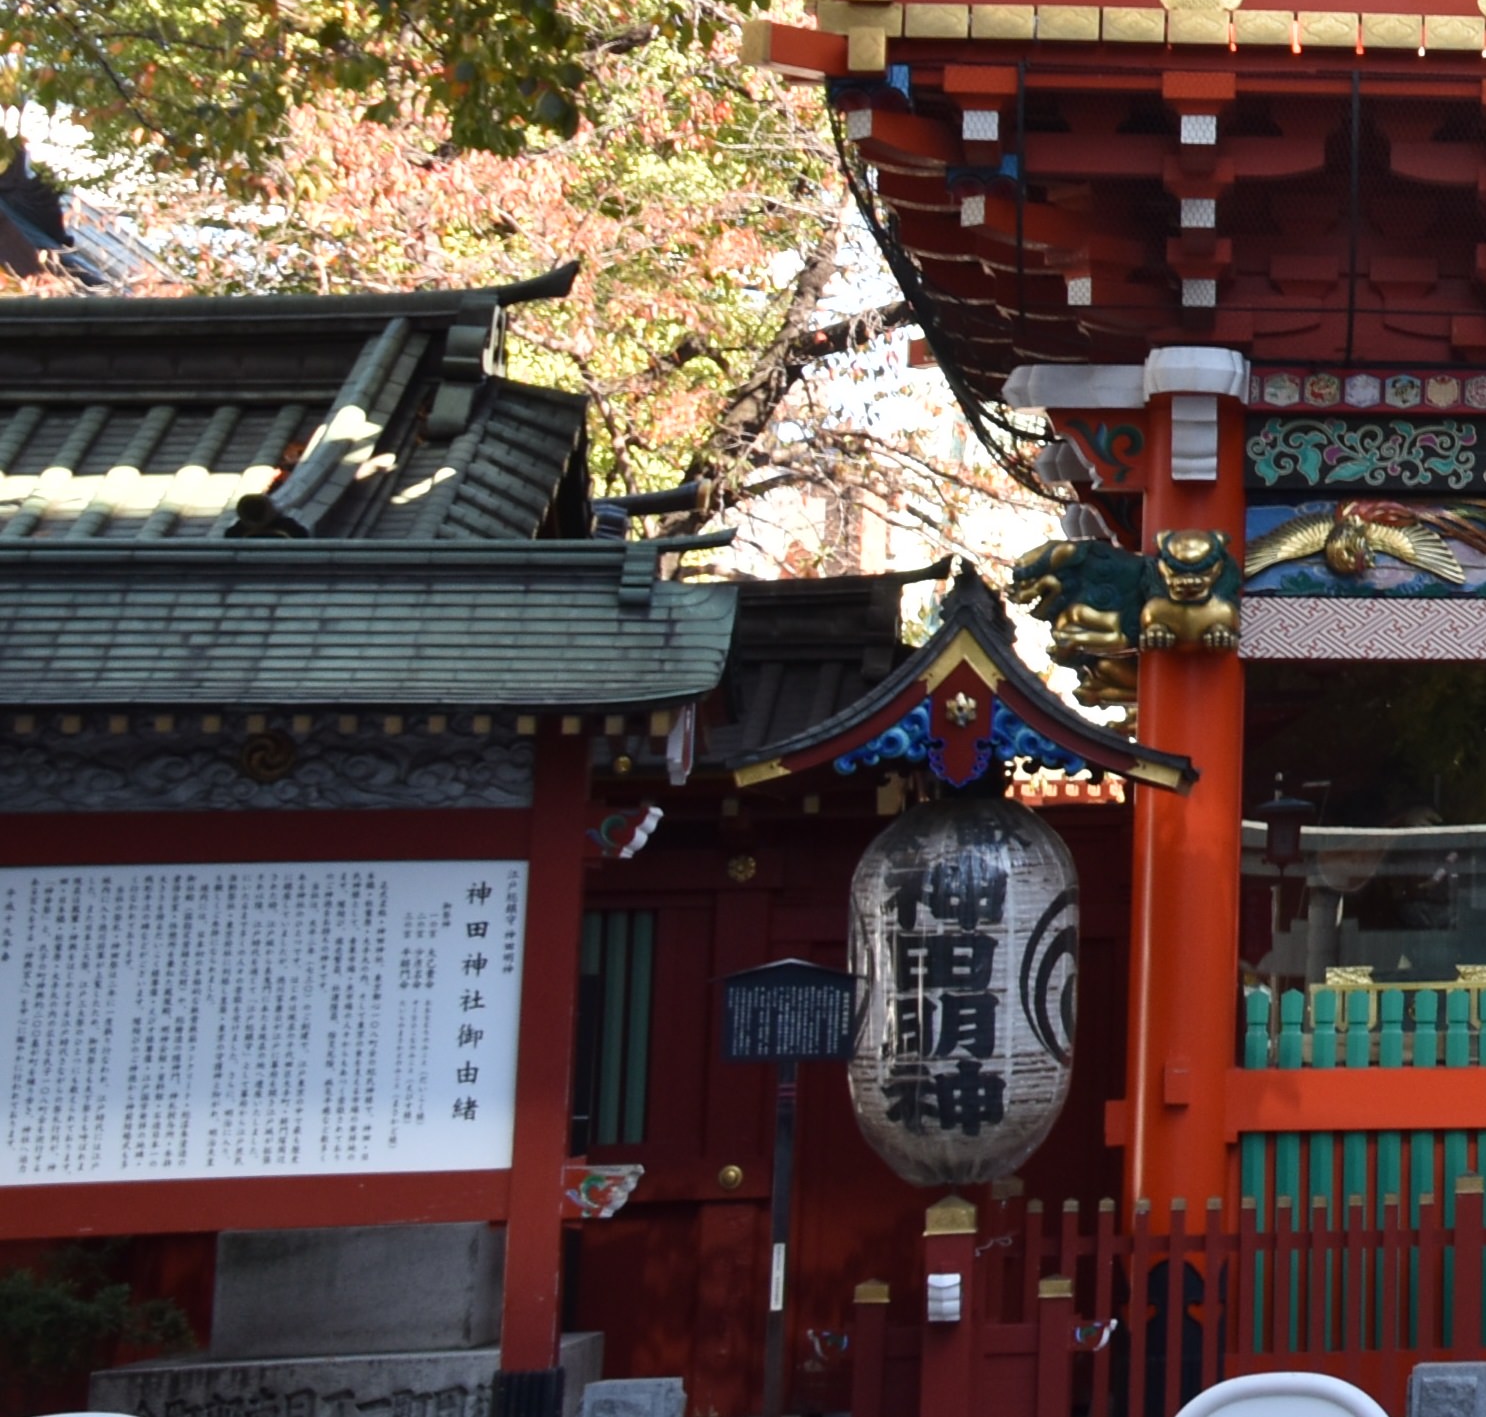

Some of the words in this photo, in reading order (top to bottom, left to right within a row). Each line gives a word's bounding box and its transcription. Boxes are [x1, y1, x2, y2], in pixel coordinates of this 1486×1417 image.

[452, 880, 493, 1121] 神田神社御由緒
[882, 846, 1008, 1135] 神田明神
